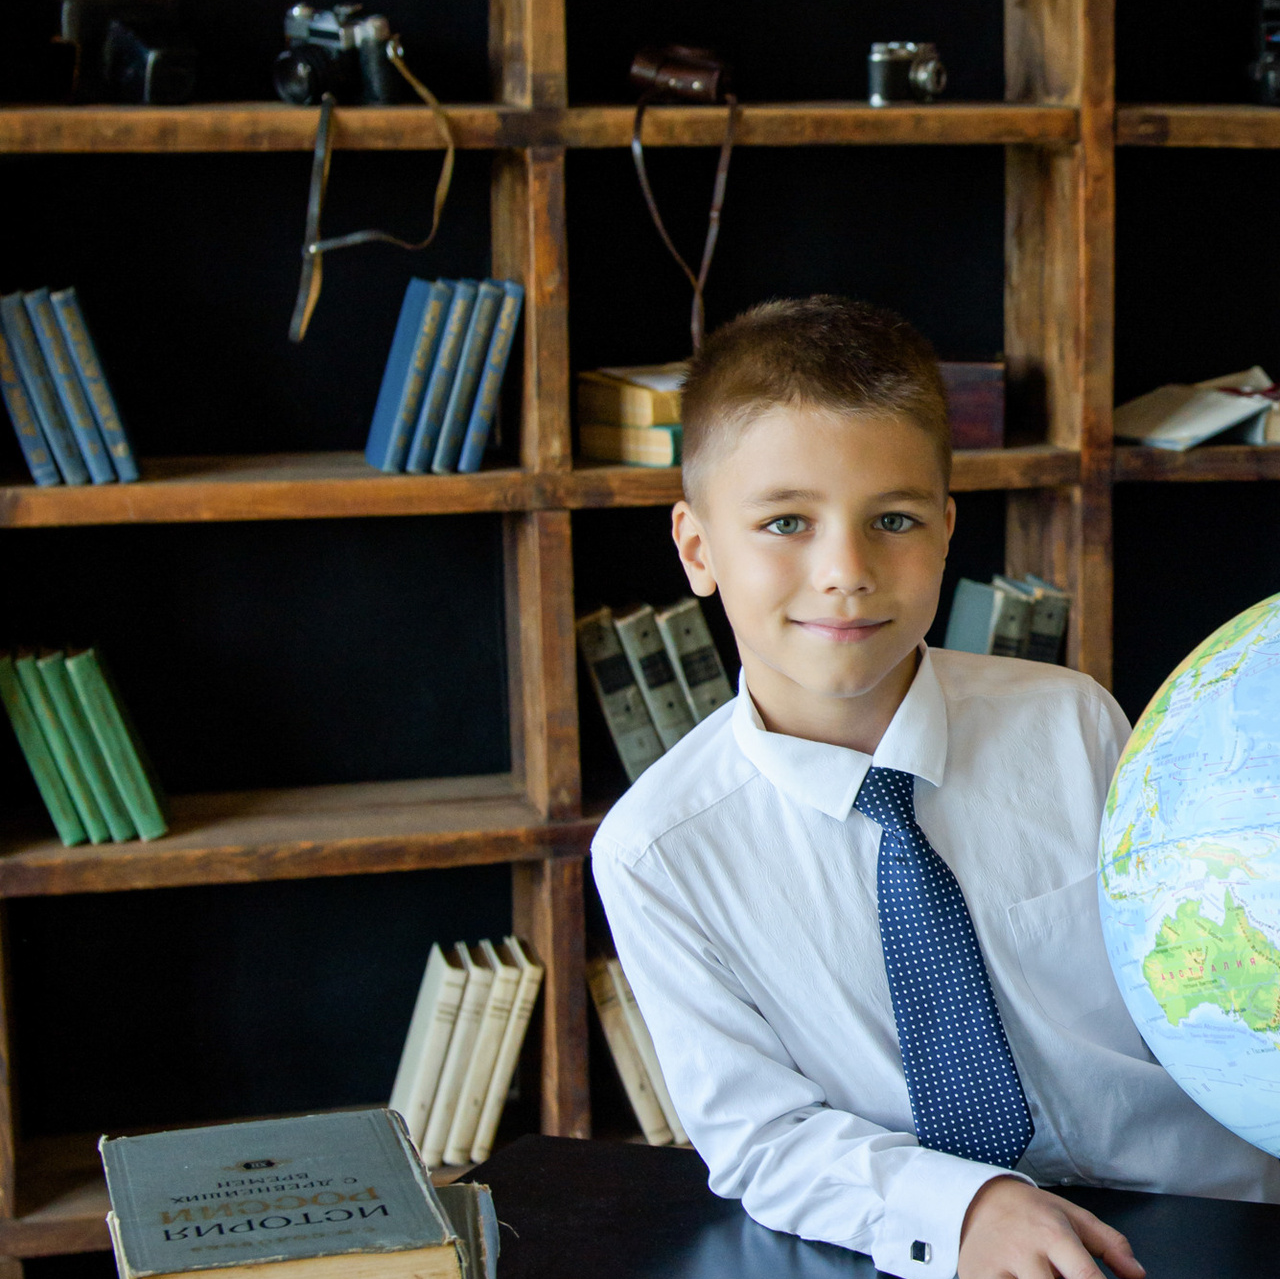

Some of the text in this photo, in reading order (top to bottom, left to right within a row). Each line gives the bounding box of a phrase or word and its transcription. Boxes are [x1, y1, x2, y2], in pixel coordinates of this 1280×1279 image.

[1161, 957, 1257, 981] АВСТРАЛИЯ
[170, 1179, 334, 1206] ДРЕВНЕЙШИХ
[216, 1171, 309, 1189] ВРЕМЕН
[159, 1187, 380, 1226] РОССИИ
[163, 1204, 389, 1243] ИСТОРИЯ
